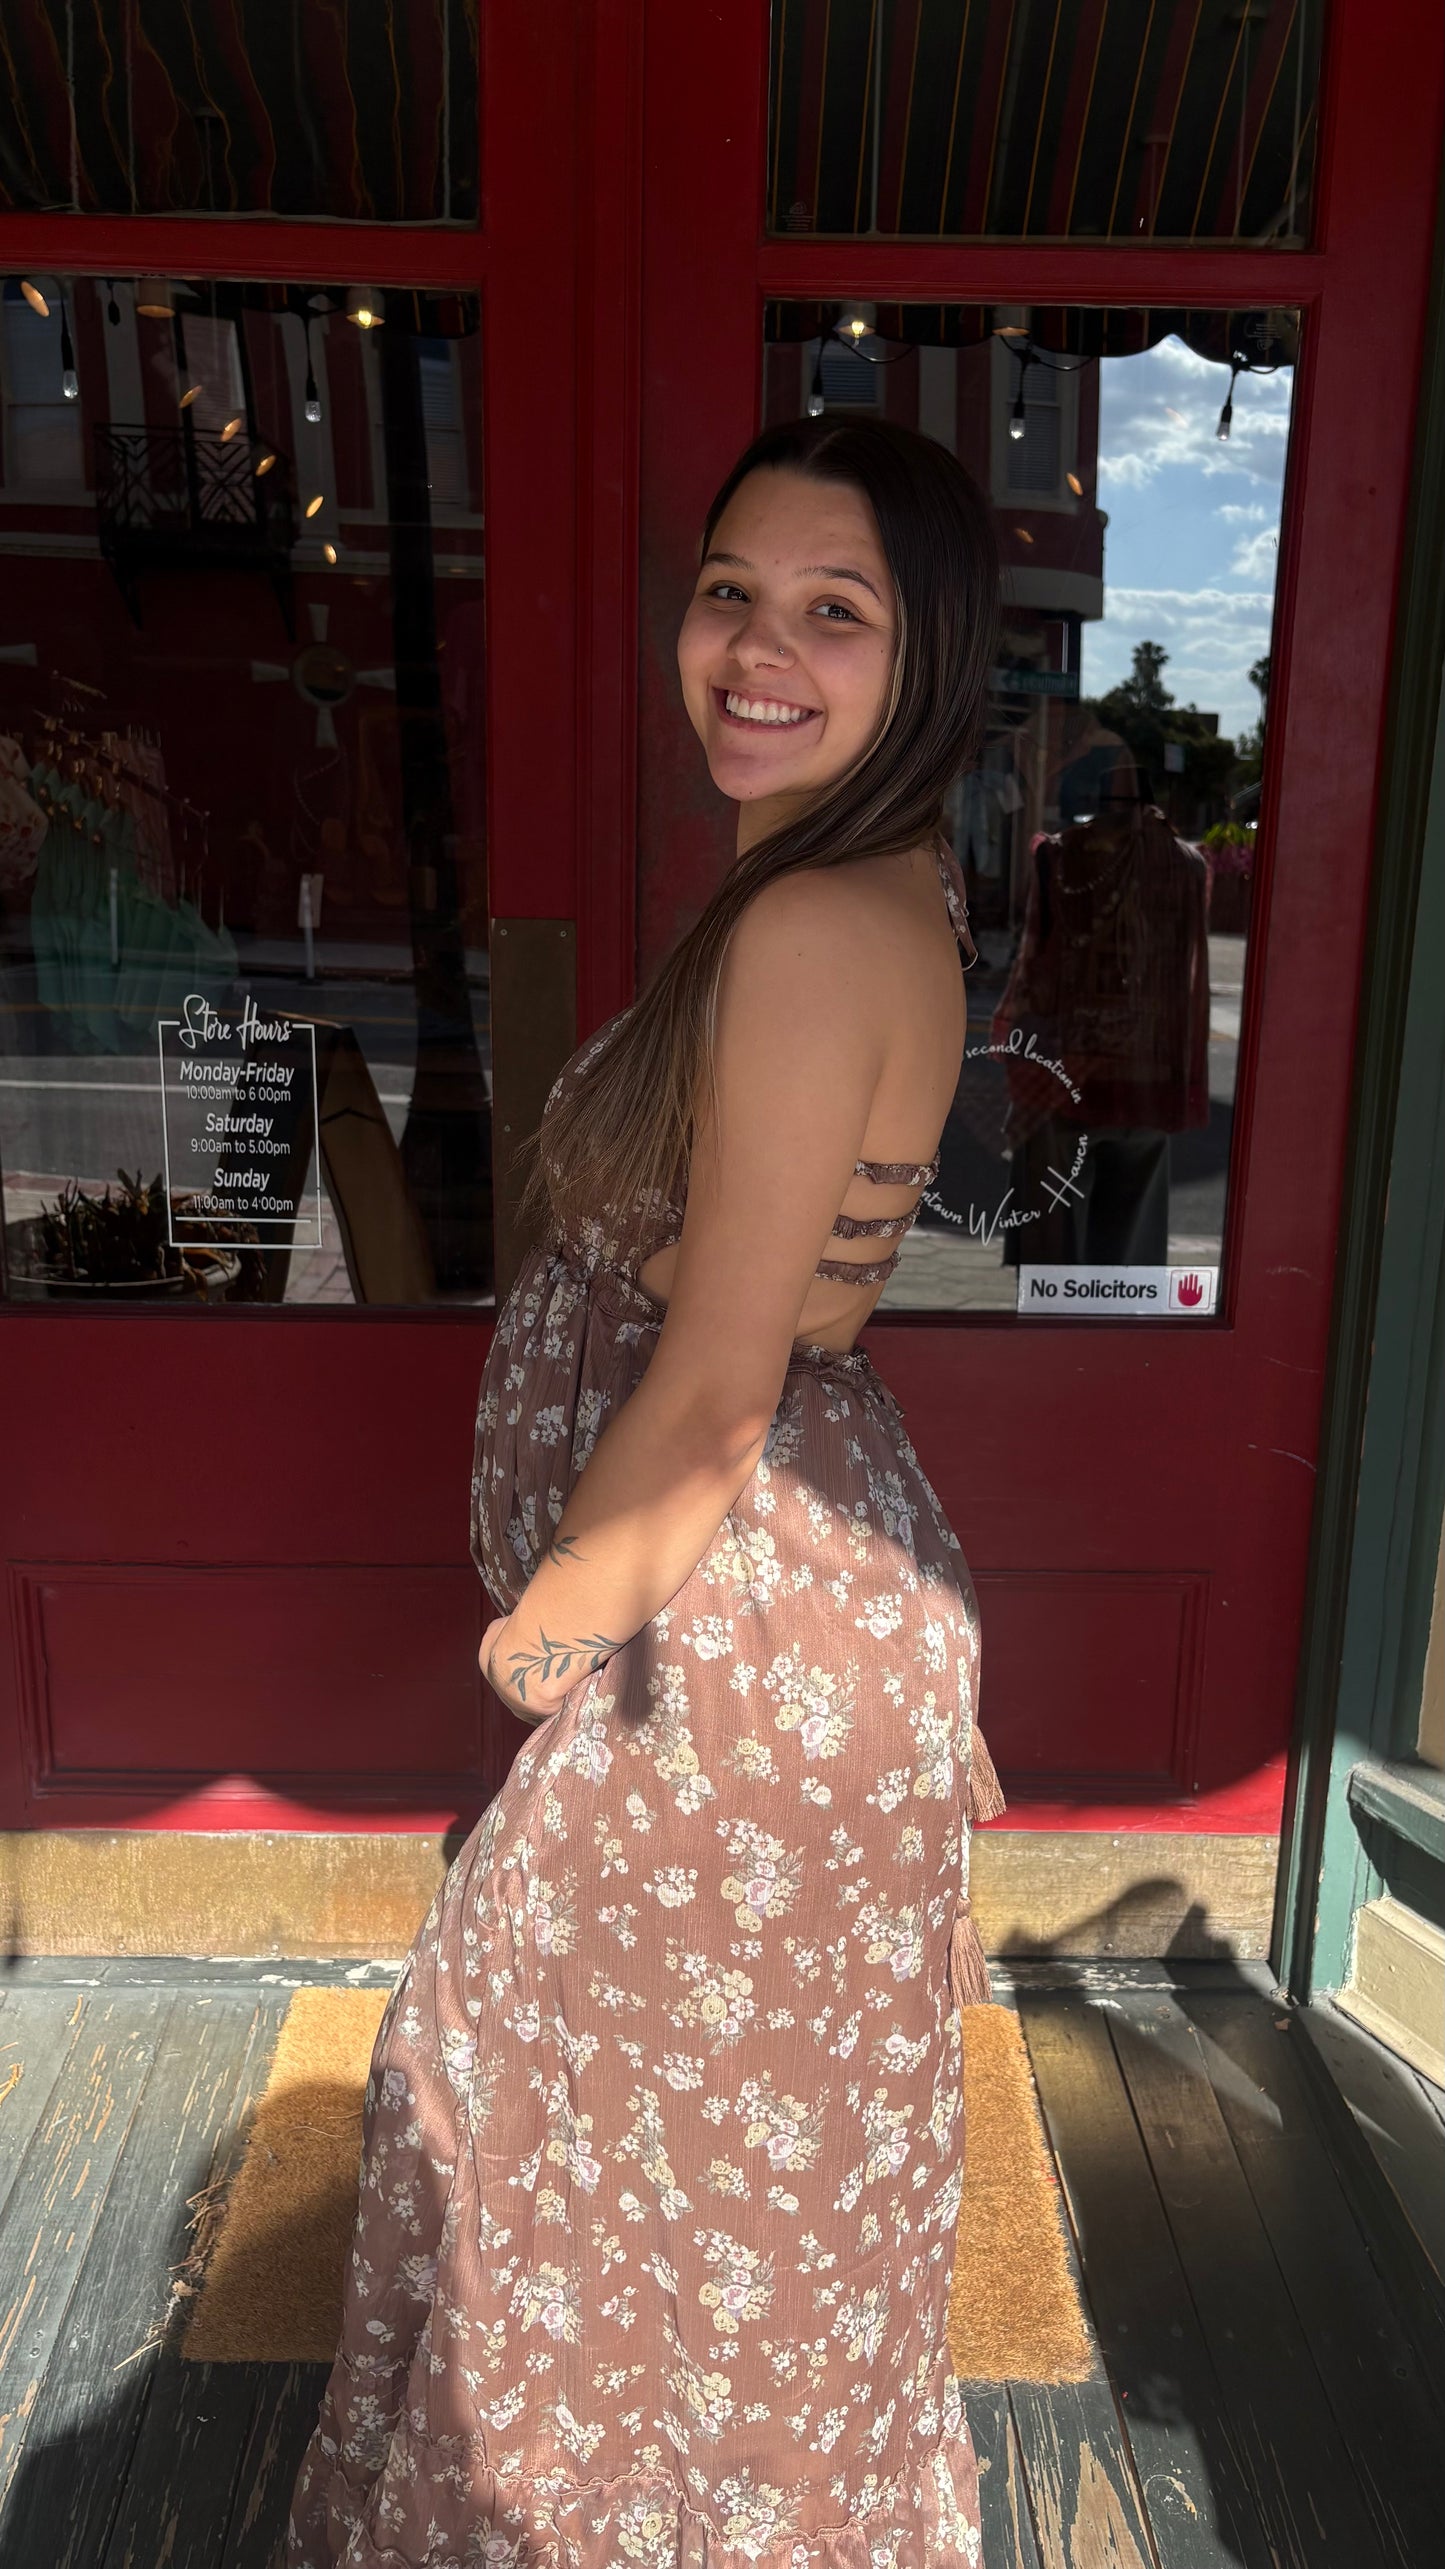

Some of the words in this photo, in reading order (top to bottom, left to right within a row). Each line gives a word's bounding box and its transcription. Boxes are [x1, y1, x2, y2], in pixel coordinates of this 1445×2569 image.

[178, 994, 232, 1050] Store
[236, 994, 292, 1050] Hours
[180, 1060, 295, 1087] Monday-Friday
[966, 1028, 1023, 1059] second
[1023, 1033, 1073, 1092] location
[1070, 1087, 1082, 1104] in
[186, 1085, 232, 1100] 10:00am
[234, 1087, 246, 1101] to
[205, 1113, 274, 1137] Saturday
[191, 1138, 232, 1153] 9:00am
[235, 1140, 246, 1154] to
[214, 1167, 270, 1192] Sunday
[968, 1187, 1041, 1246] Winter
[1040, 1134, 1088, 1214] Haven
[193, 1195, 235, 1209] 11:00am
[237, 1196, 249, 1210] to
[1030, 1278, 1058, 1298] No
[1063, 1279, 1158, 1299] Solicitors
